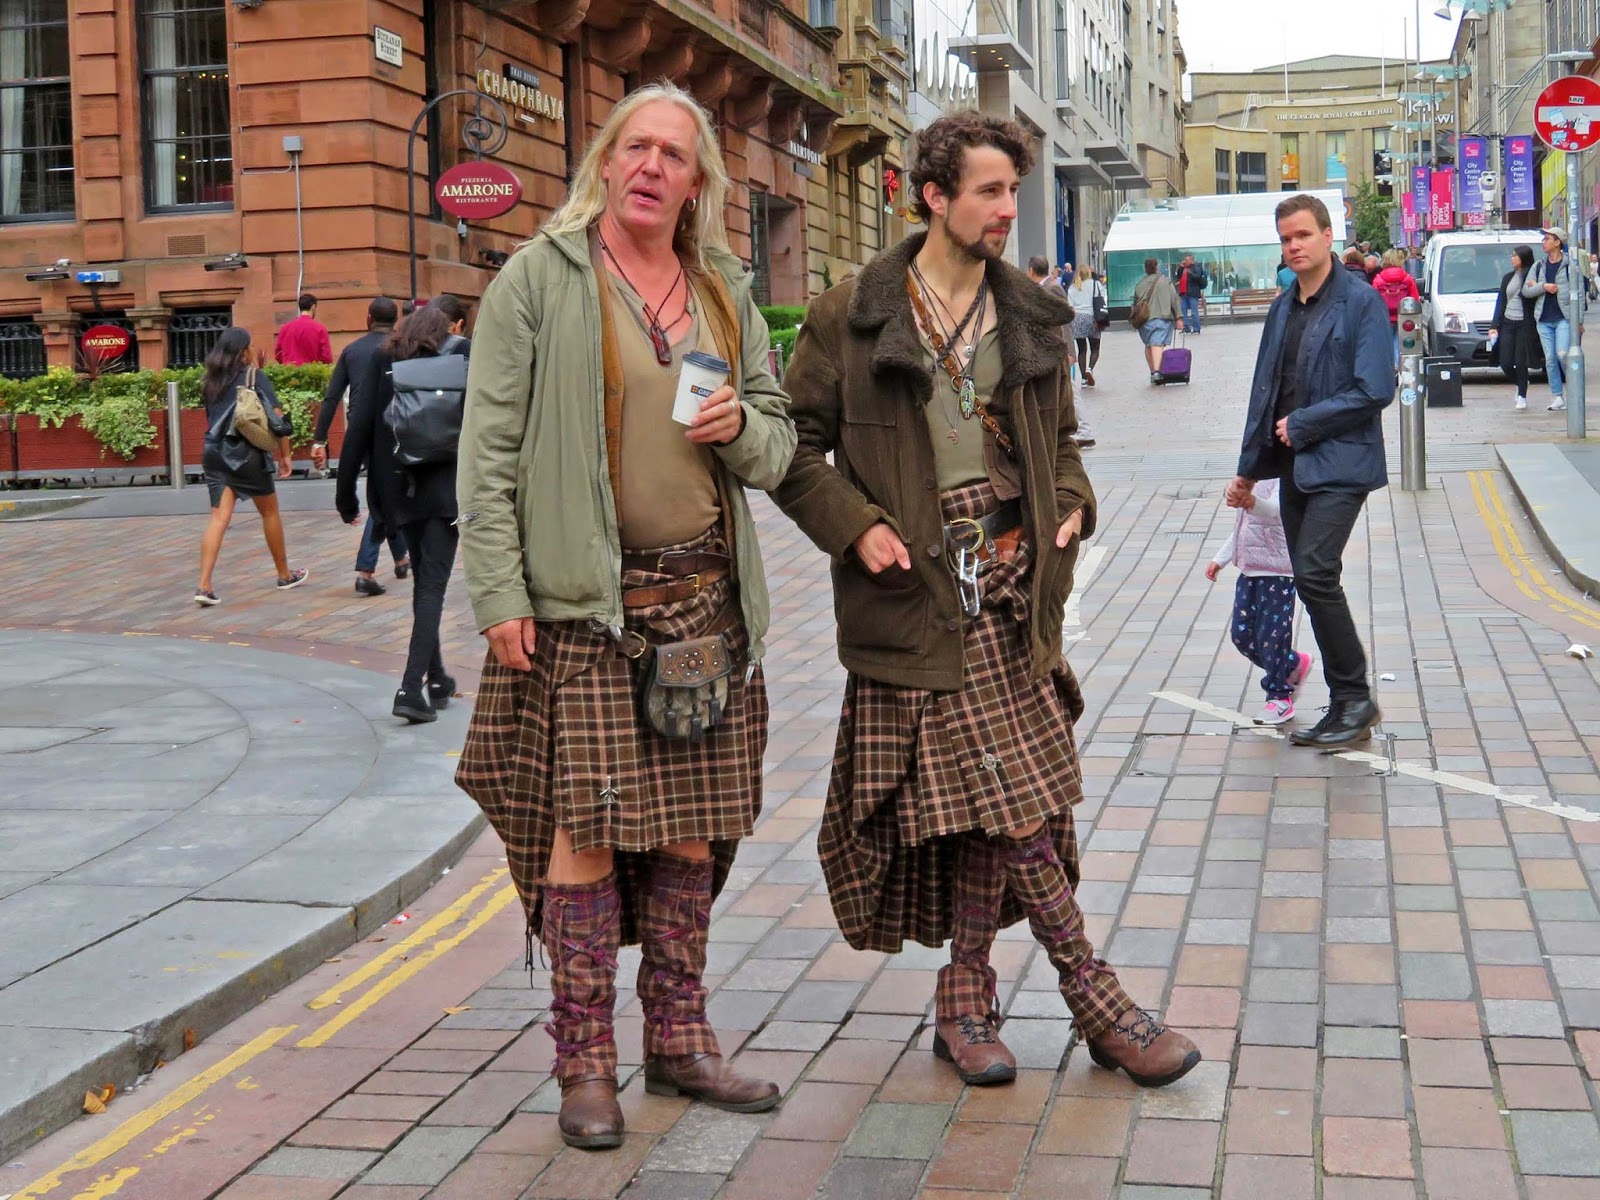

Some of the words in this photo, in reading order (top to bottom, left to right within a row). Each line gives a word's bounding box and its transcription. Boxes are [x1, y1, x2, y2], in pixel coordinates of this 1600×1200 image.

[381, 42, 398, 57] STREET
[482, 69, 564, 121] CHAOPHRAYA
[1345, 110, 1375, 118] CONCERT
[440, 183, 514, 197] AMARONE
[85, 337, 126, 347] AMARONE
